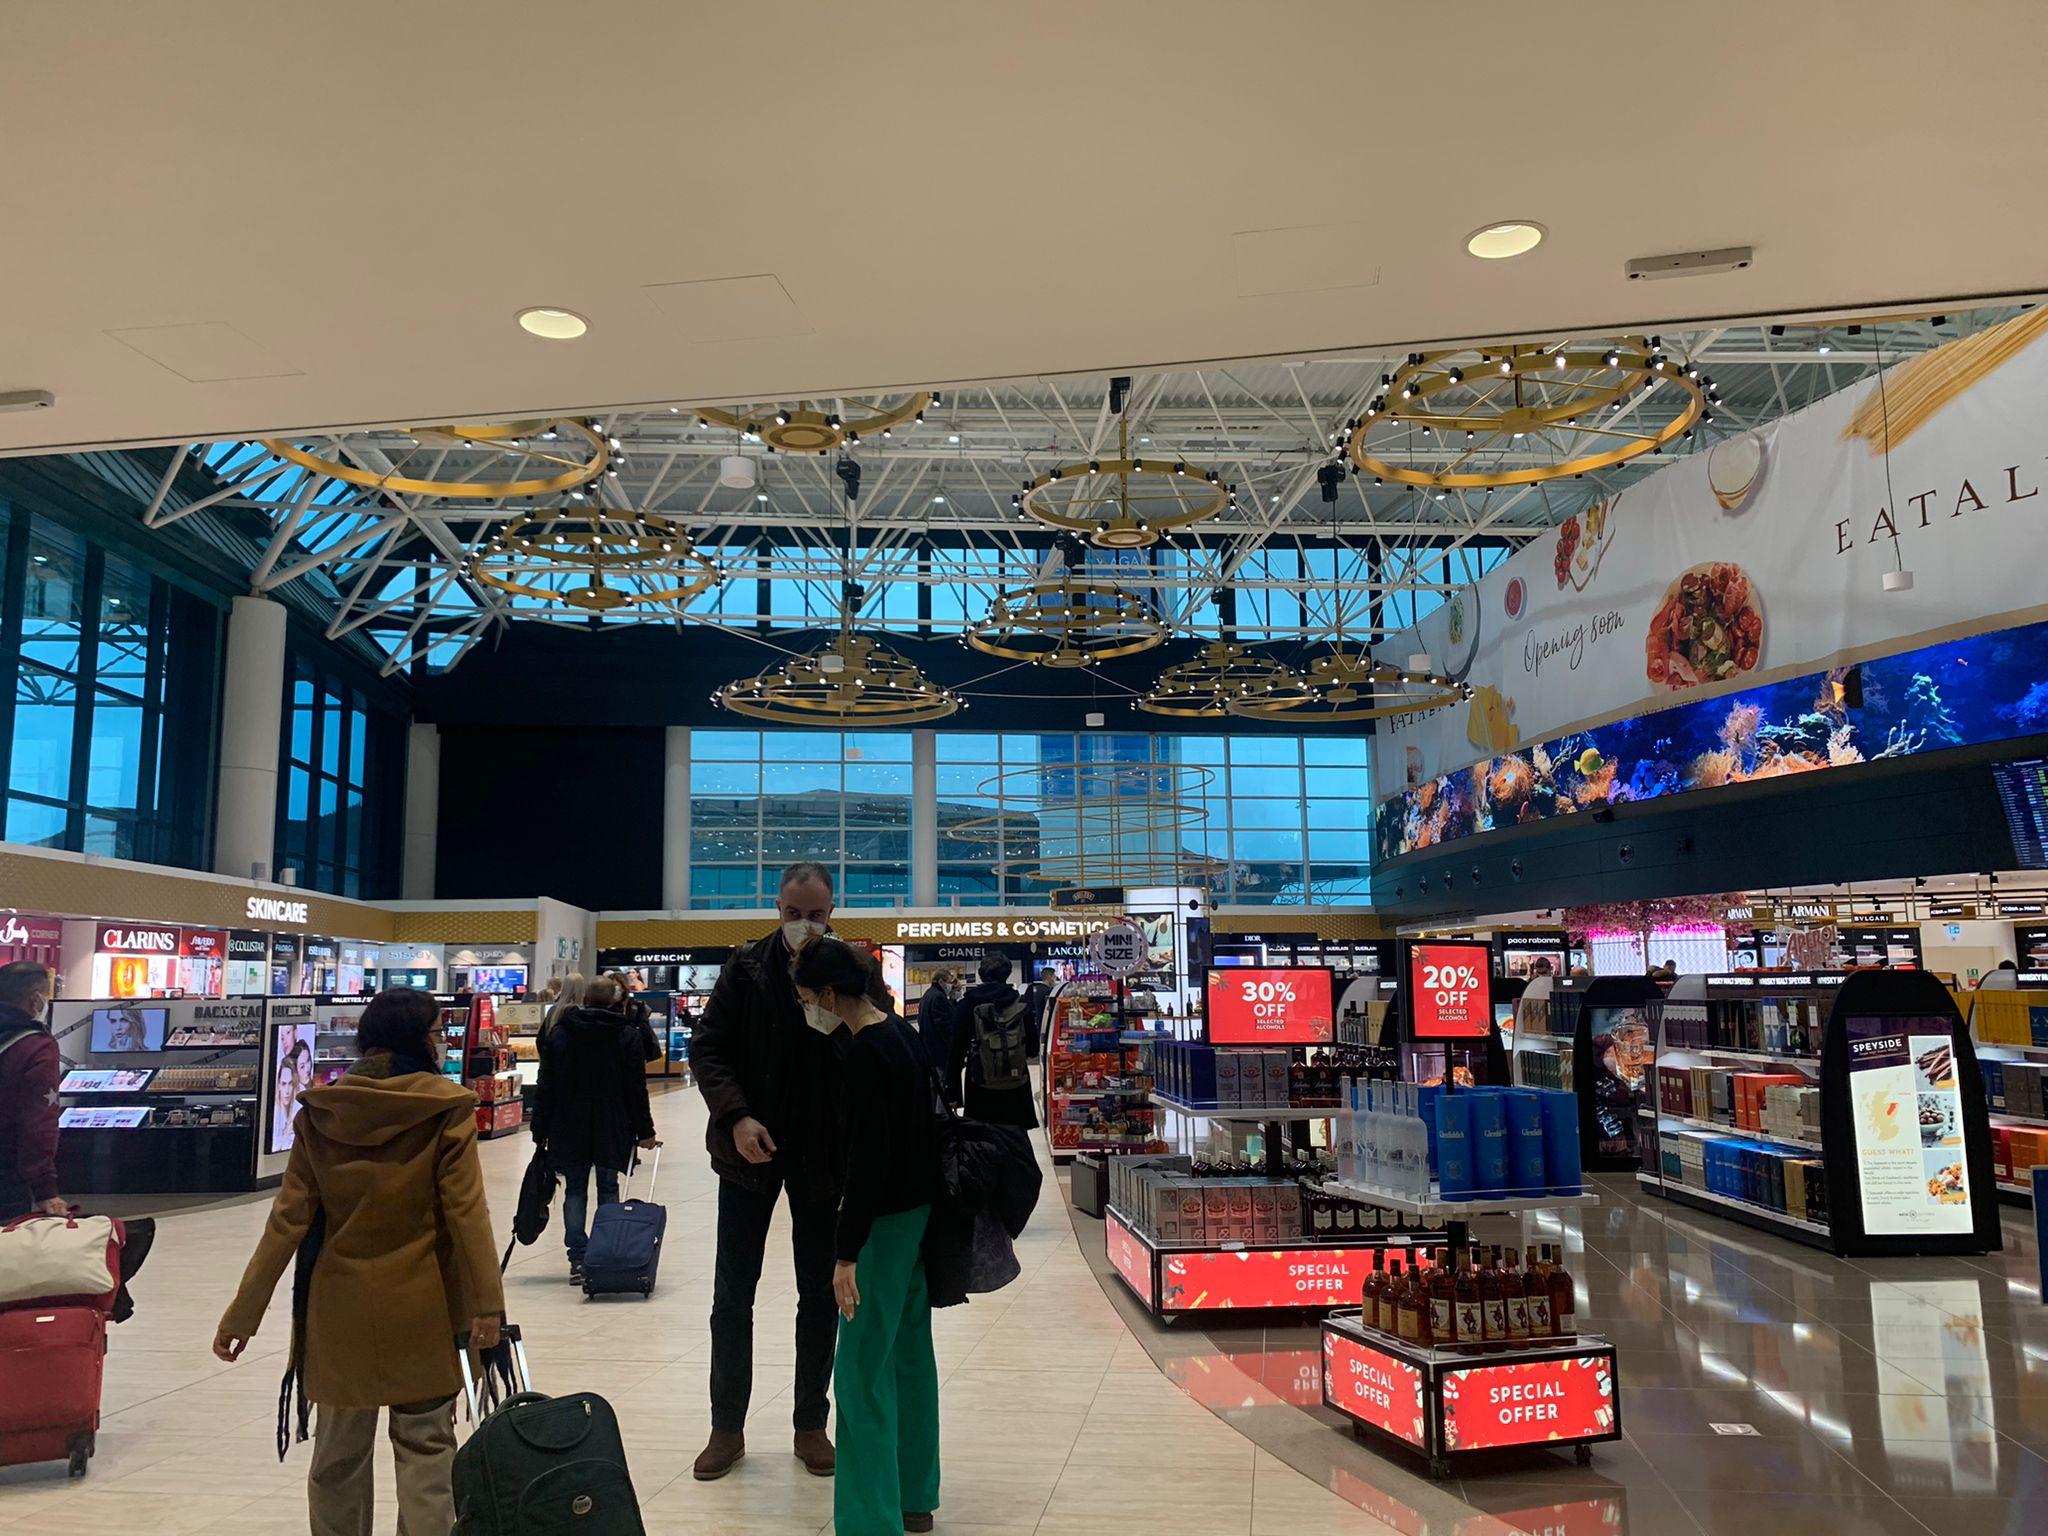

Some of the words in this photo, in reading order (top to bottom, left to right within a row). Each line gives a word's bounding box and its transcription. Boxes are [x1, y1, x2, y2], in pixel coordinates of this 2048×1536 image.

[1834, 456, 2048, 555] EATAL
[1524, 624, 1588, 677] Opening
[1590, 611, 1625, 643] soon
[246, 896, 308, 923] SKINCARE
[1727, 906, 1753, 920] ARMANI
[1790, 905, 1830, 917] ARMANI
[1853, 915, 1889, 923] BVLGARI
[896, 922, 993, 938] PERFUMES
[996, 921, 1009, 936] &
[103, 928, 175, 950] CLARINS
[1104, 934, 1133, 946] MINI
[1507, 937, 1528, 945] paco
[1528, 936, 1561, 944] rabanne
[634, 954, 692, 962] GIVENCHY
[1104, 948, 1133, 960] SIZE
[1423, 965, 1479, 989] 20%
[2017, 973, 2041, 981] WHISKY
[1241, 981, 1297, 1002] 30%
[1435, 991, 1469, 1007] OFF
[1253, 1003, 1286, 1017] OFF
[1852, 1038, 1903, 1053] SPEYSIDE
[1289, 1263, 1350, 1276] SPECIAL
[1296, 1279, 1344, 1291] OFFER
[1350, 1358, 1396, 1392] SPECIAL
[1355, 1381, 1391, 1410] OFFER
[1490, 1380, 1565, 1404] SPECIAL
[1499, 1403, 1559, 1425] OFFER
